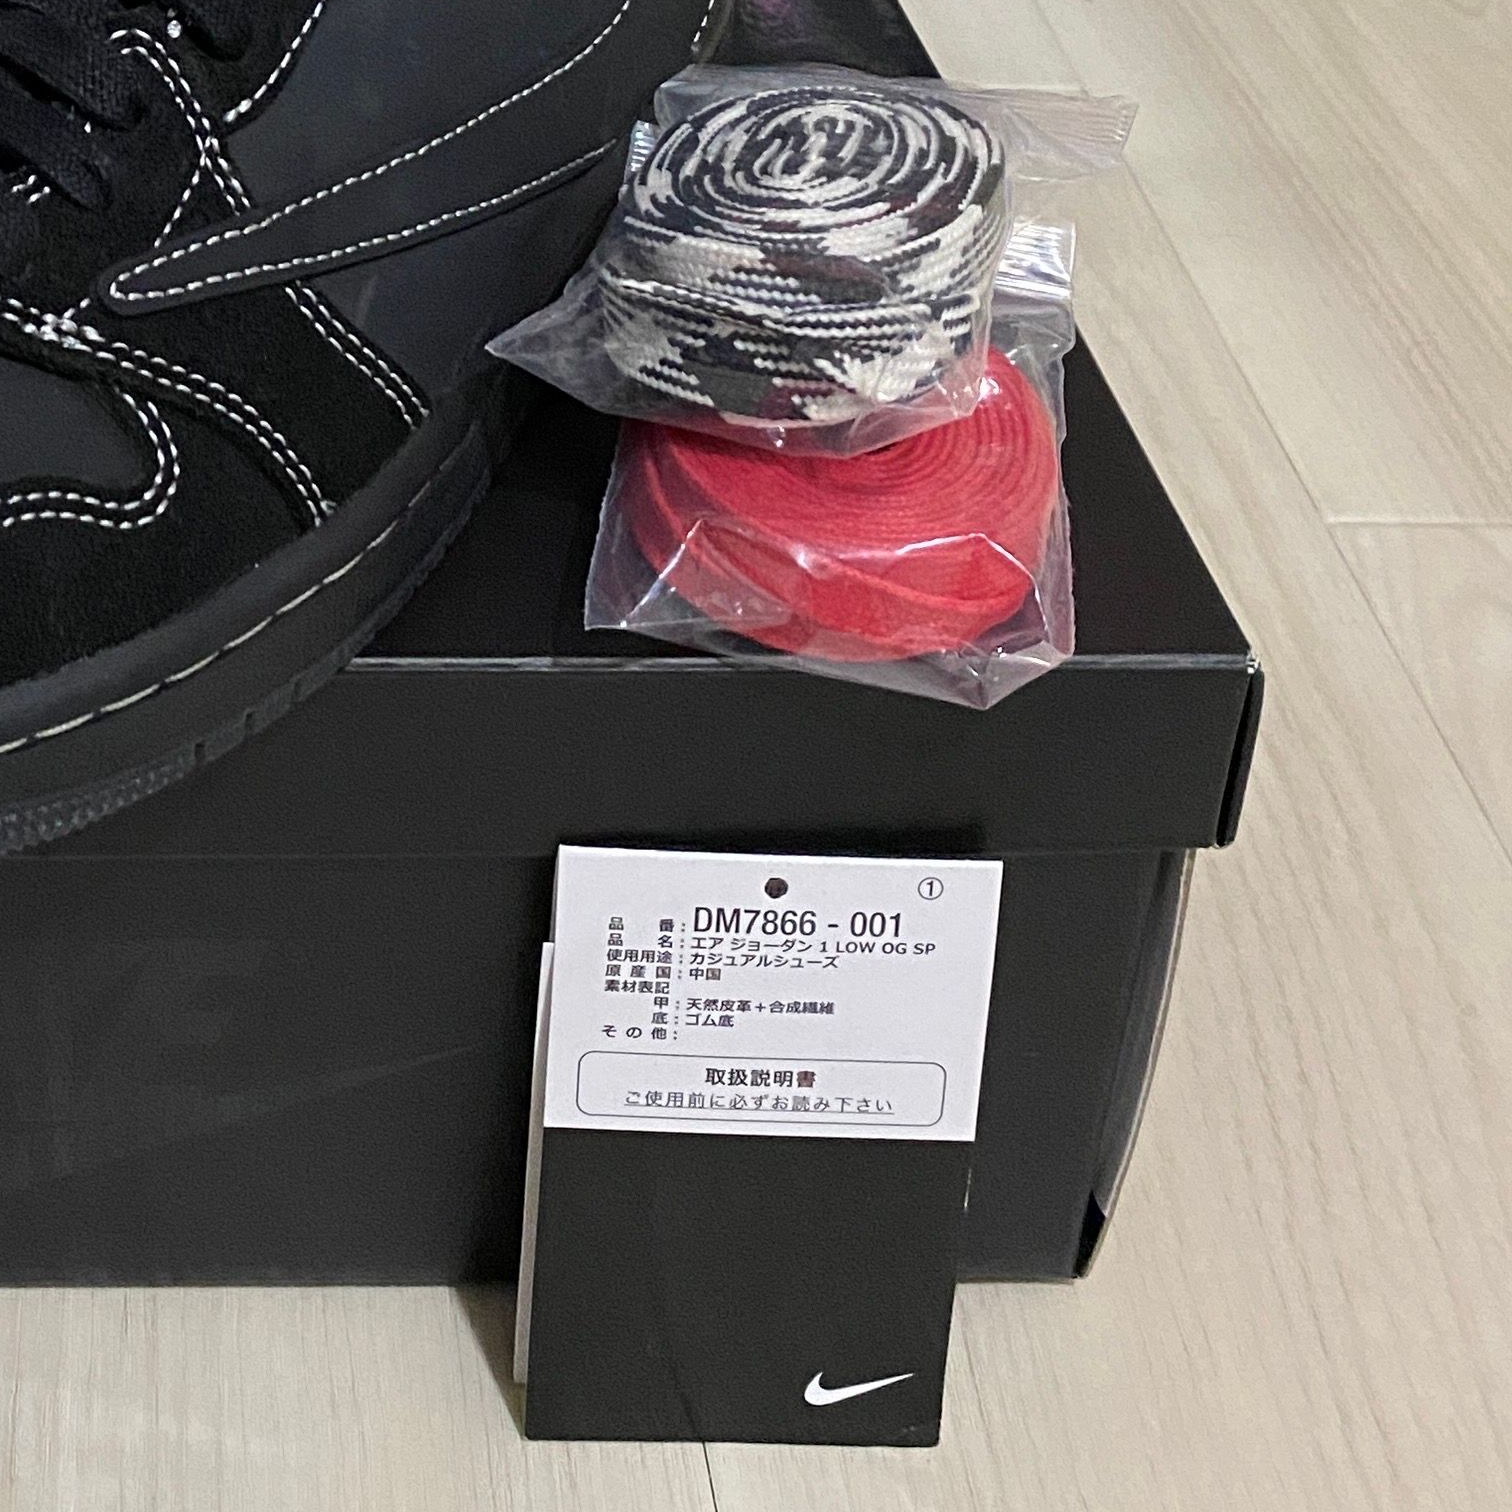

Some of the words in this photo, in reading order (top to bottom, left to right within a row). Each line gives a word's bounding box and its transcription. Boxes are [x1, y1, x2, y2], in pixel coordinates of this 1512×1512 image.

[694, 907, 817, 936] DM7866
[850, 911, 901, 937] 001
[691, 937, 724, 950] エア
[730, 938, 813, 952] ジョーダン
[820, 941, 828, 953] 1
[836, 941, 876, 954] LOW
[882, 942, 907, 954] OG
[913, 943, 936, 955] SP
[690, 952, 840, 969] カジュアルシューズ
[689, 967, 722, 981] 中国
[604, 979, 670, 995] 素材表記
[685, 1013, 735, 1027] ゴム底
[705, 1067, 817, 1088] 取扱説明書
[624, 1090, 894, 1113] ご使用前に必ずお読み下さい
